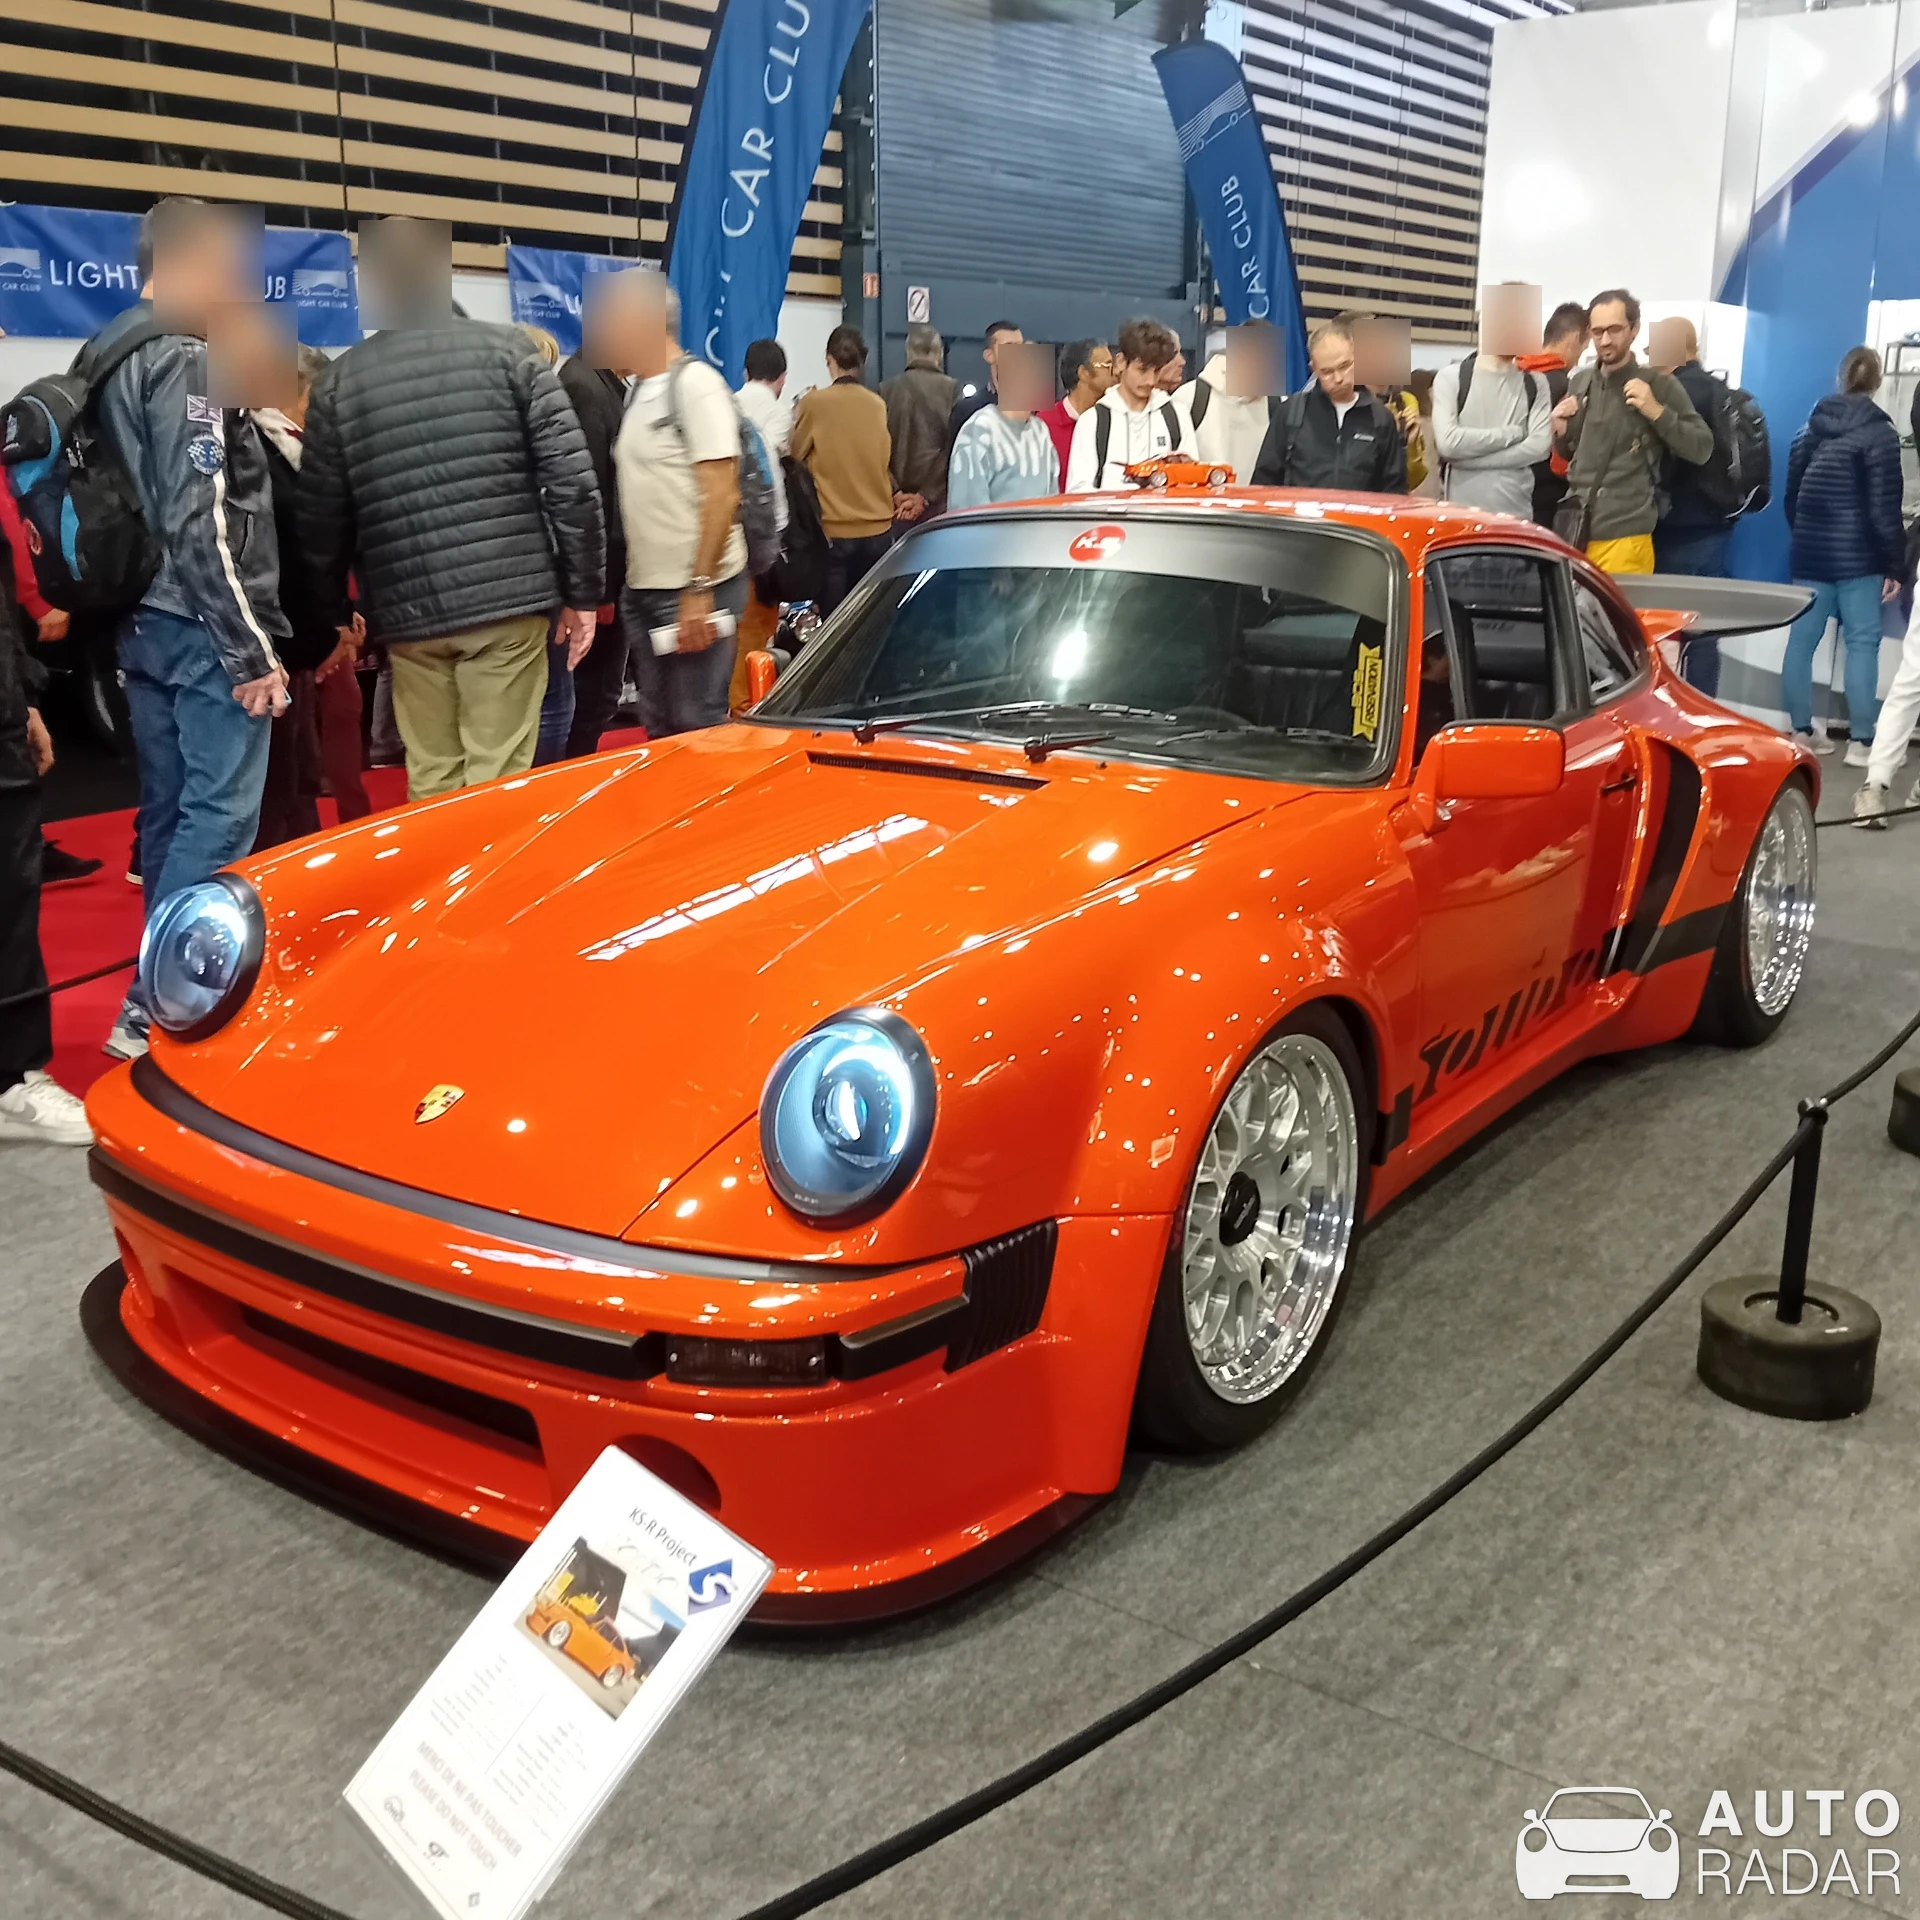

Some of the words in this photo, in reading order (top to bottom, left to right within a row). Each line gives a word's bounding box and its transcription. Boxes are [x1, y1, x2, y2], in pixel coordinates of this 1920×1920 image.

[721, 127, 775, 238] CAR
[763, 0, 810, 104] CLU
[1220, 175, 1252, 249] CLUB
[49, 258, 139, 290] LIGHT
[1240, 254, 1270, 320] CAR
[629, 1506, 658, 1535] KS-R
[654, 1527, 698, 1567] Project
[409, 1768, 439, 1805] PLEASE
[435, 1798, 451, 1819] DO
[449, 1813, 469, 1838] NOT
